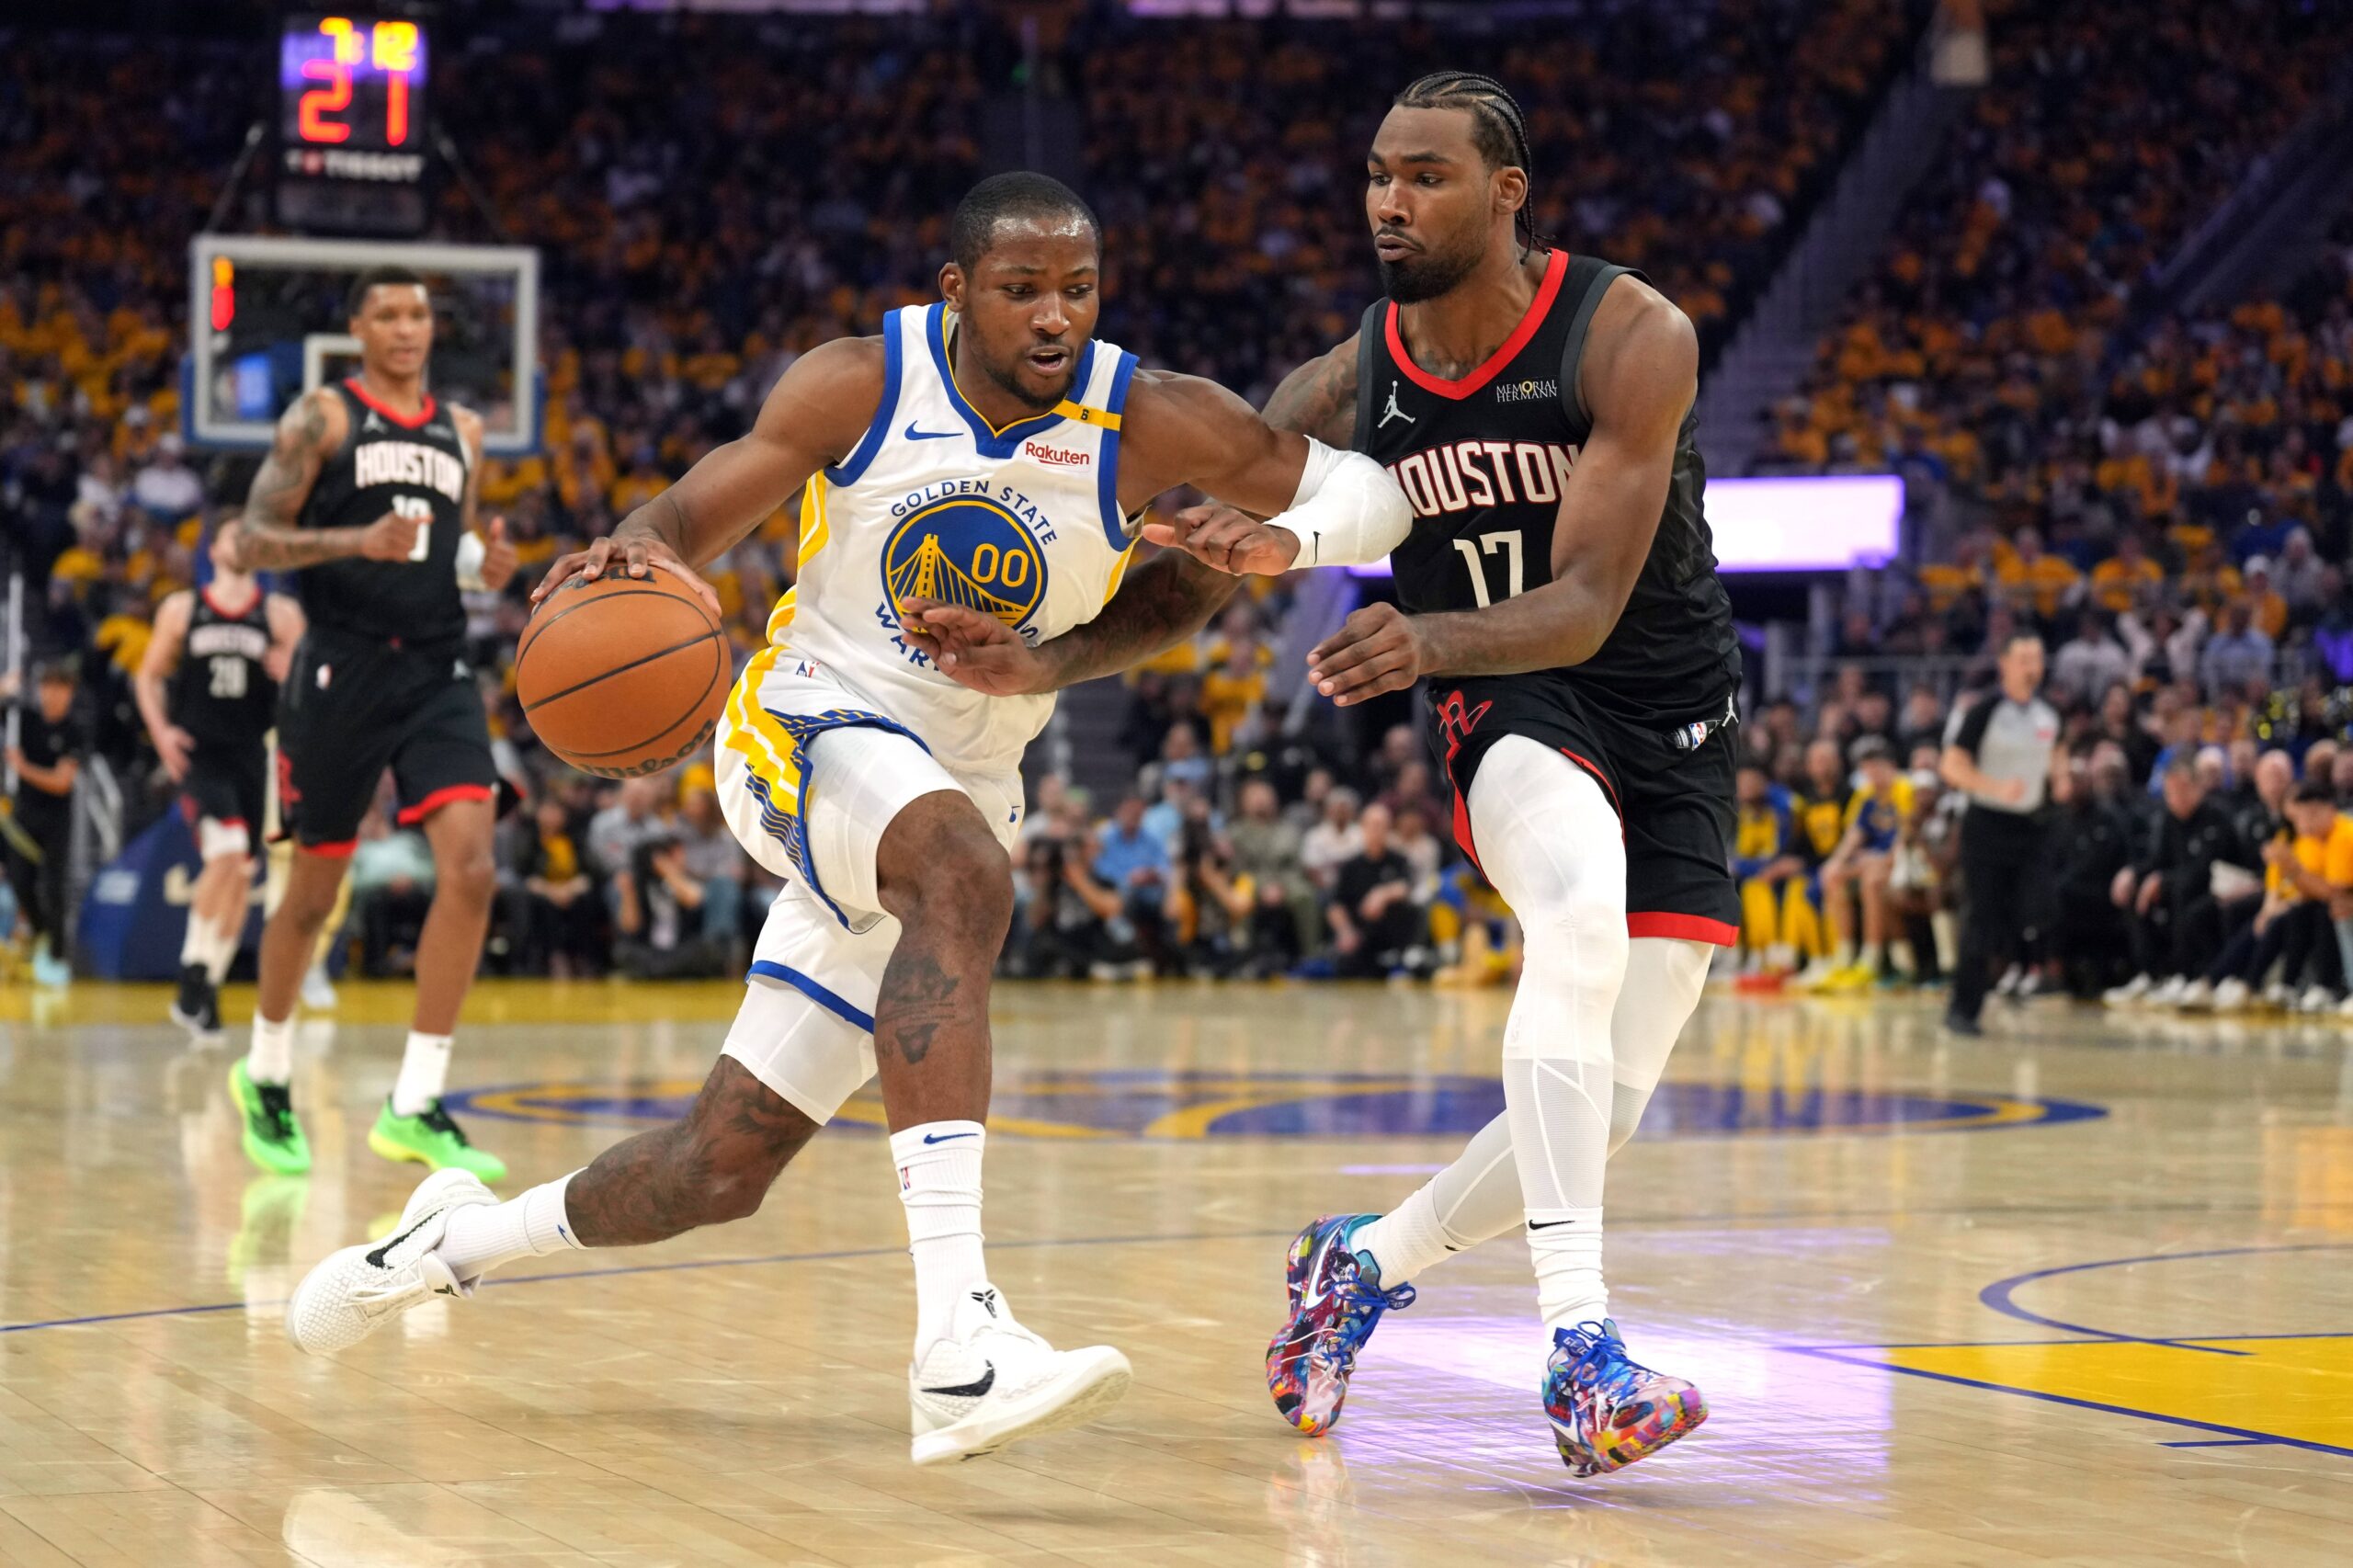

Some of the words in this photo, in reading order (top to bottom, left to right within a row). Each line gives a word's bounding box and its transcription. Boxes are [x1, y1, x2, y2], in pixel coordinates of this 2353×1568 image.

[299, 59, 408, 146] 21
[1496, 380, 1557, 394] MEMORIAL
[1496, 387, 1557, 403] HERMANN
[355, 441, 463, 504] HOUSTON
[1026, 442, 1089, 465] Rakuten
[1385, 441, 1581, 518] OUSTON
[891, 481, 989, 517] GOLDEN
[1000, 486, 1057, 545] STATE
[972, 543, 1029, 587] 00
[1453, 529, 1523, 608] 17
